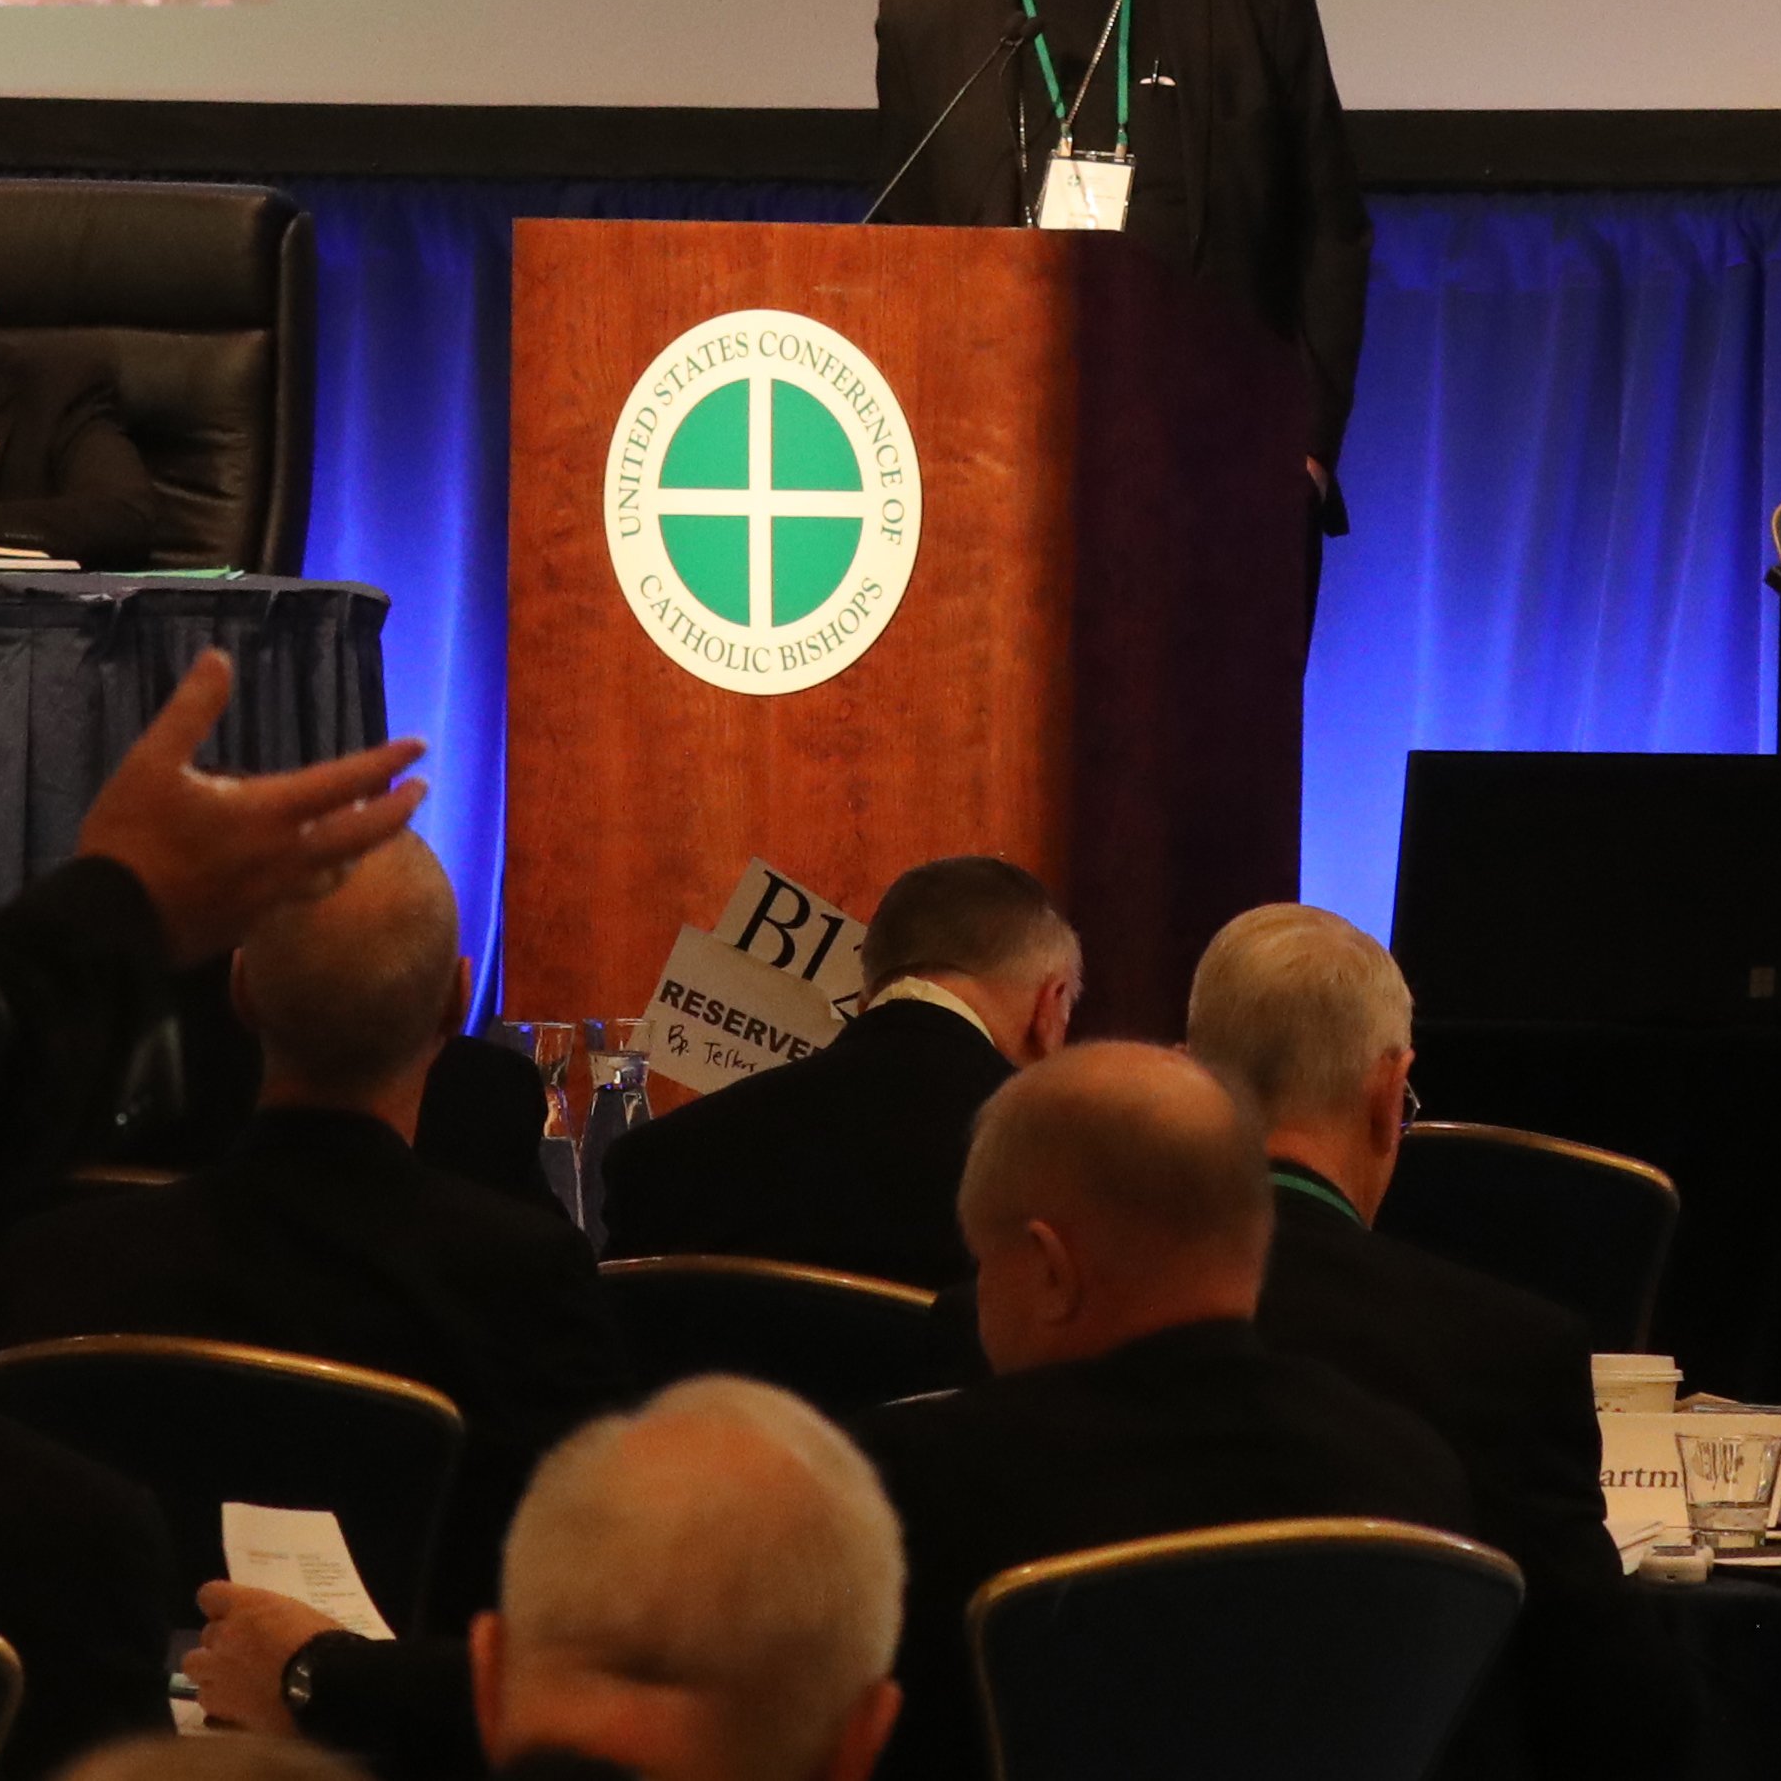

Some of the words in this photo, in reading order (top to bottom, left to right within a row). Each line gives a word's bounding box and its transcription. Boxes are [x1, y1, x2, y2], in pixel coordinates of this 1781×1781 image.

[618, 405, 659, 540] UNITED
[653, 330, 750, 407] STATES
[758, 330, 904, 489] CONFERENCE
[881, 497, 906, 546] OF
[639, 573, 771, 674] CATHOLIC
[778, 576, 883, 673] BISHOPS
[658, 978, 826, 1063] RESERVE
